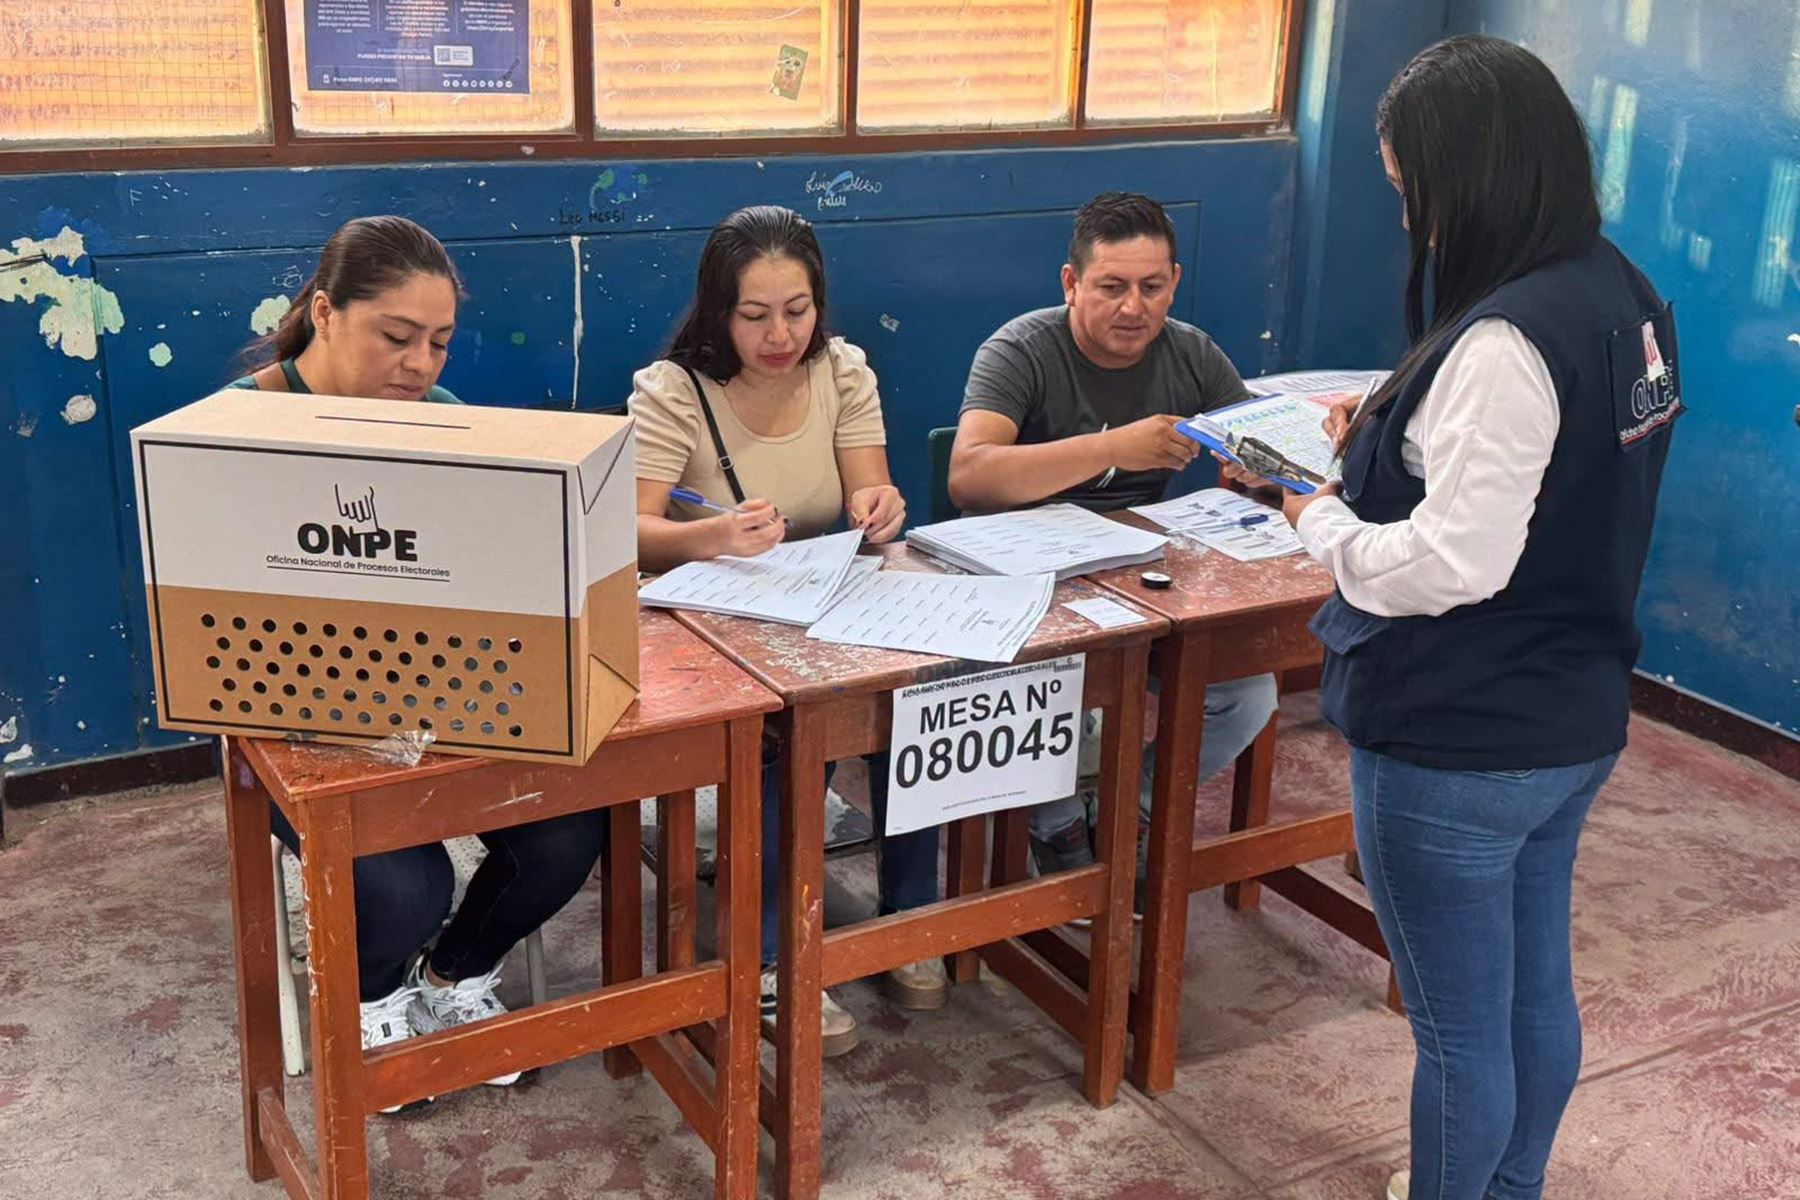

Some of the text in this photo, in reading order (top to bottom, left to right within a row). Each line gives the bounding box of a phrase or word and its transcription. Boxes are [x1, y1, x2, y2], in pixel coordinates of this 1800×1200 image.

[297, 522, 418, 562] ONPE
[266, 554, 450, 578] Oficina Nacional de Procesos Electorales
[920, 689, 1017, 735] MESA
[896, 711, 1074, 789] 080045
